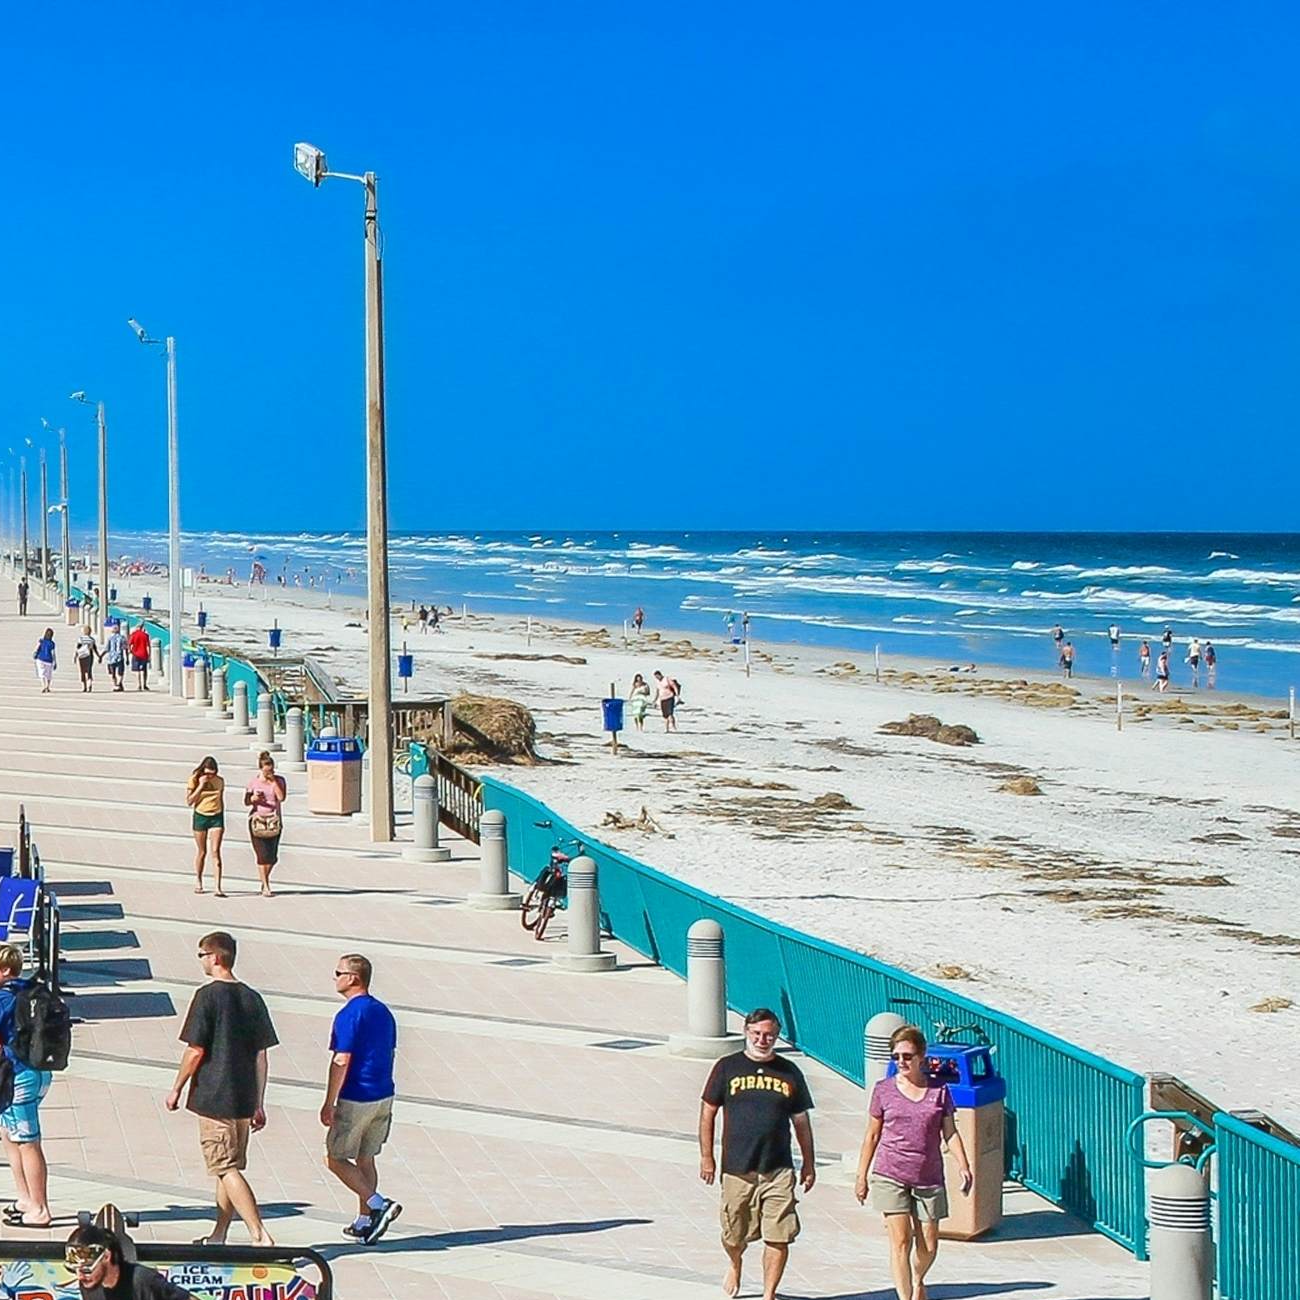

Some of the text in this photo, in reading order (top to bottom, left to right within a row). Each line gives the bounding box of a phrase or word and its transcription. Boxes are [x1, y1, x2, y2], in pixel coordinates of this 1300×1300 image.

[729, 1074, 791, 1098] PIRATES
[183, 1265, 209, 1275] ICE
[170, 1275, 223, 1285] CREAM
